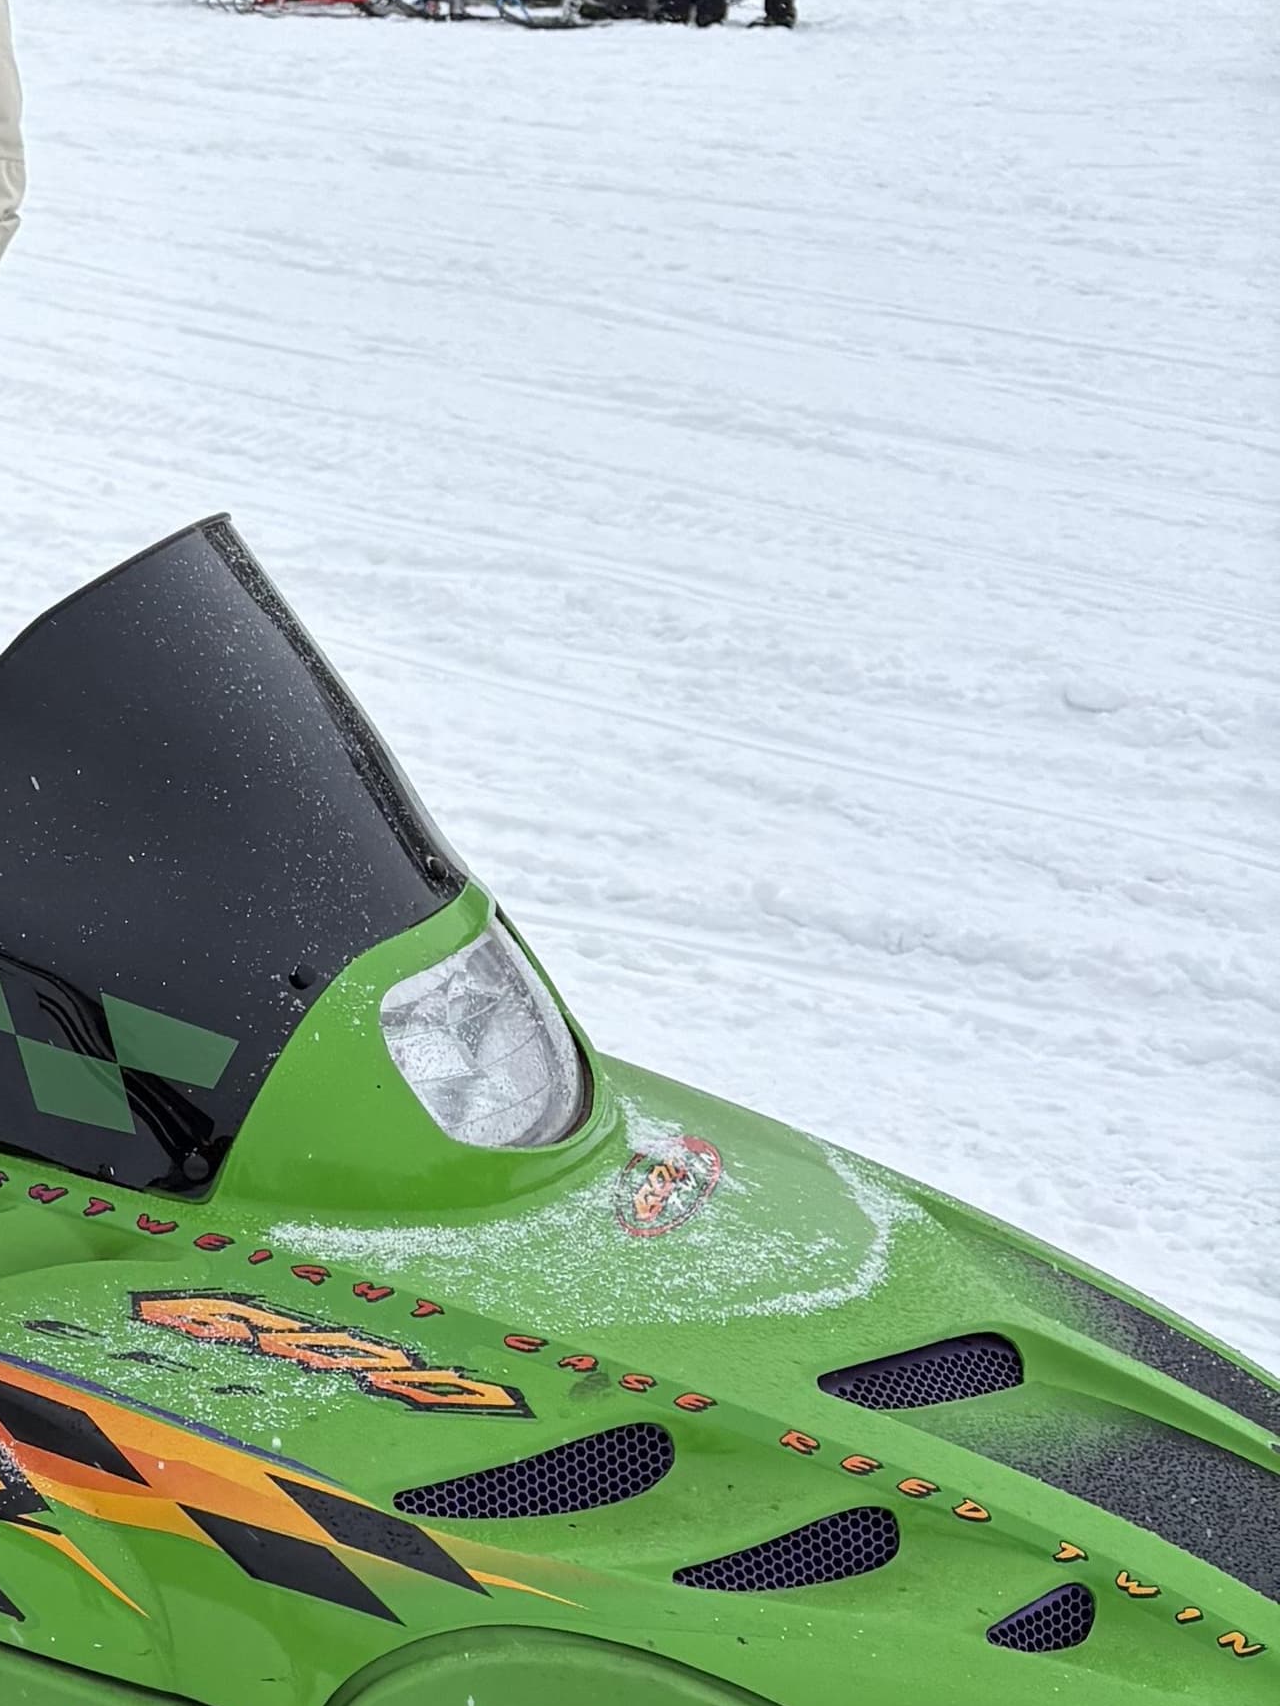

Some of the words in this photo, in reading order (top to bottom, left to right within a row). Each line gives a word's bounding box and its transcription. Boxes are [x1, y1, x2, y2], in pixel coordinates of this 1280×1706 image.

[503, 1332, 717, 1413] CASE
[779, 1428, 992, 1523] REED
[1052, 1539, 1268, 1657] TWIN
